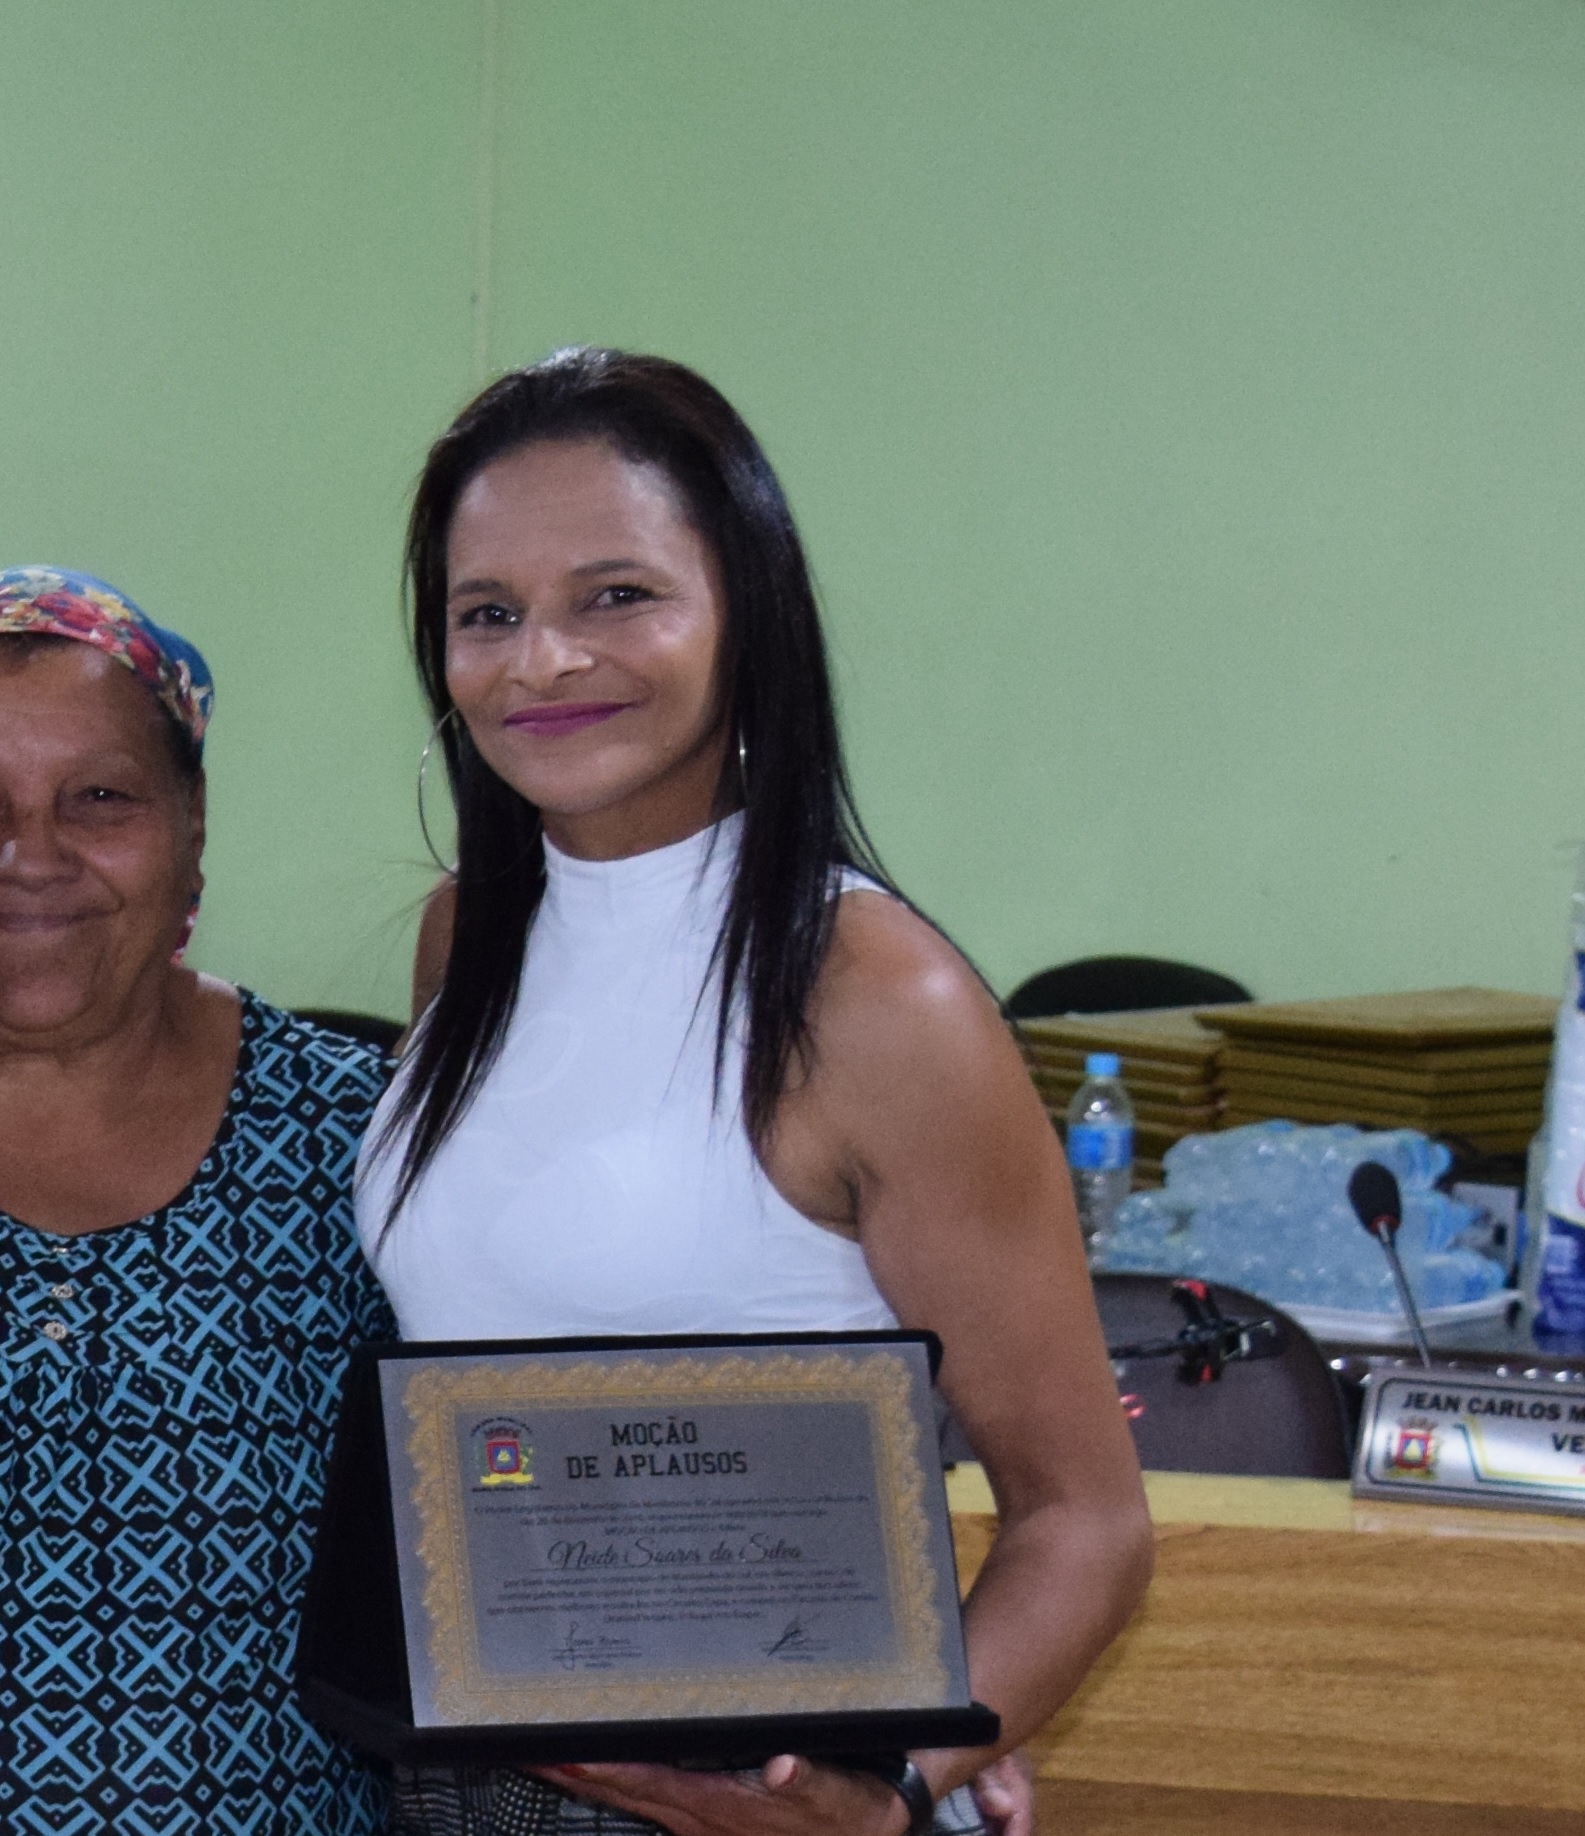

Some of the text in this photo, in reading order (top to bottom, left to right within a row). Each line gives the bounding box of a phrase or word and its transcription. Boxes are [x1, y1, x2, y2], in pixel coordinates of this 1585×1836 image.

[1402, 1392, 1461, 1412] JEAN
[1467, 1397, 1562, 1421] CARLOS
[611, 1415, 698, 1448] MOÇÃO
[566, 1451, 748, 1480] DE APLAUSOS
